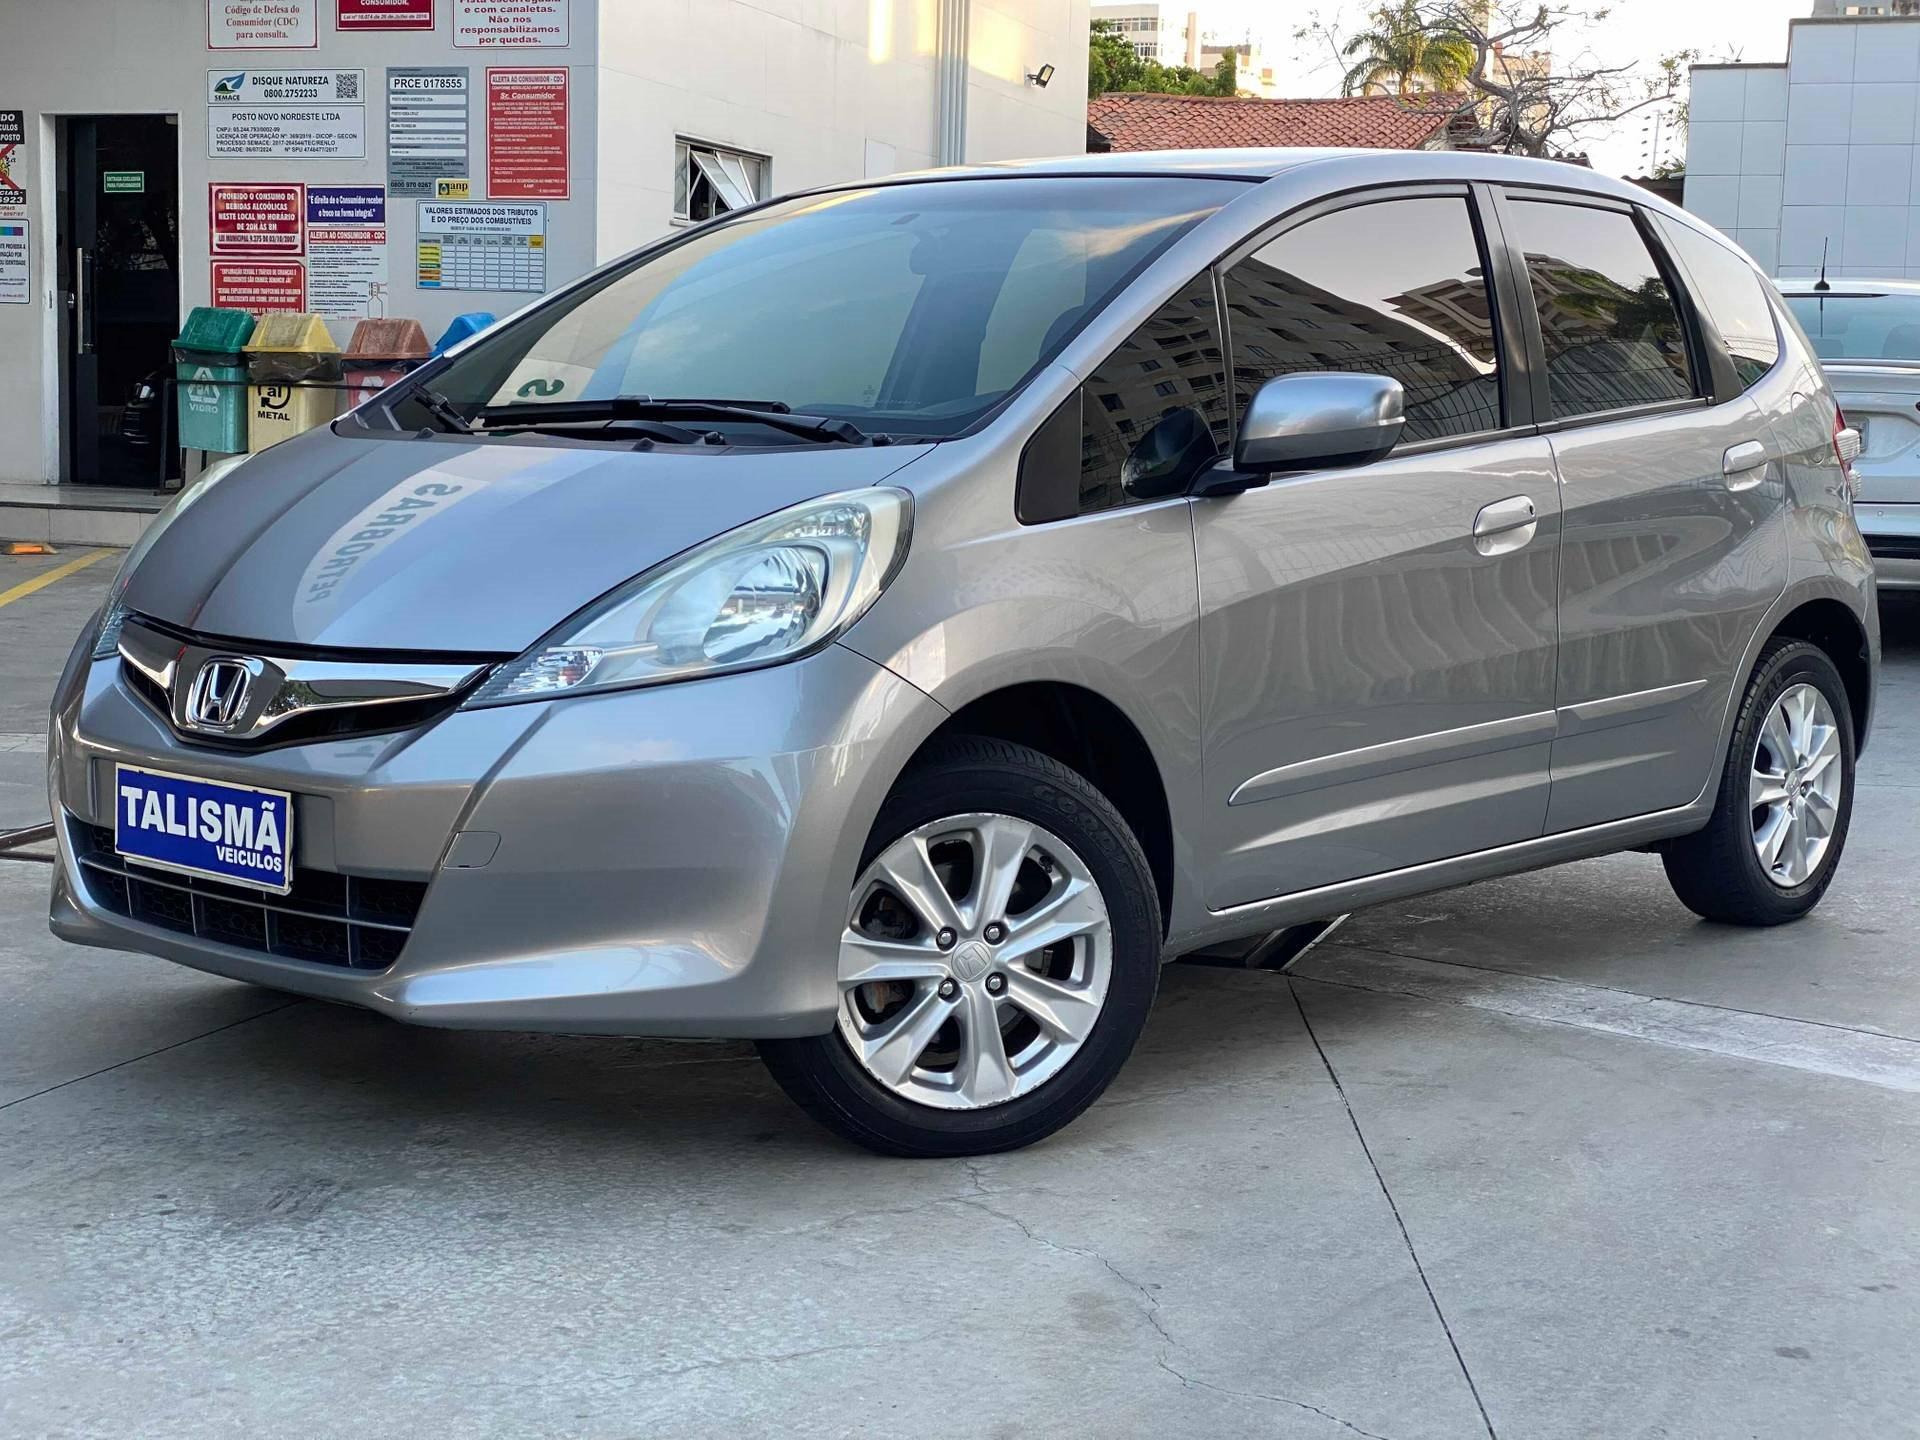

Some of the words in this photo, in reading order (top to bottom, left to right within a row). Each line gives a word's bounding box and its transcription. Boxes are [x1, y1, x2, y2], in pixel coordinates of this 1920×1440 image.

[225, 6, 250, 15] Código
[253, 6, 262, 14] de
[264, 5, 288, 14] Defesa
[290, 5, 300, 13] do
[226, 18, 272, 26] Consumidor
[274, 17, 298, 27] (CDC)
[236, 32, 253, 40] para
[255, 30, 288, 38] consulta.
[460, 26, 560, 35] responsabilizamos
[479, 36, 496, 45] por
[499, 36, 541, 44] quedas.
[252, 76, 283, 86] DISQUE
[286, 76, 329, 86] NATUREZA
[394, 78, 421, 88] PRCE
[423, 78, 462, 88] 0178555
[264, 89, 318, 98] 0800.2752233
[450, 183, 468, 191] anp
[340, 196, 365, 204] Consumidor
[366, 196, 383, 204] receber
[252, 202, 287, 210] ALCOÓLICAS
[267, 212, 295, 220] HORÁRIO
[341, 208, 354, 217] forma
[448, 217, 469, 225] PREÇO
[260, 222, 267, 230] ÀS
[189, 402, 218, 413] VIDRO
[257, 410, 290, 421] METAL
[121, 785, 281, 854] TALISMÃ
[216, 845, 282, 873] VEICULOS
